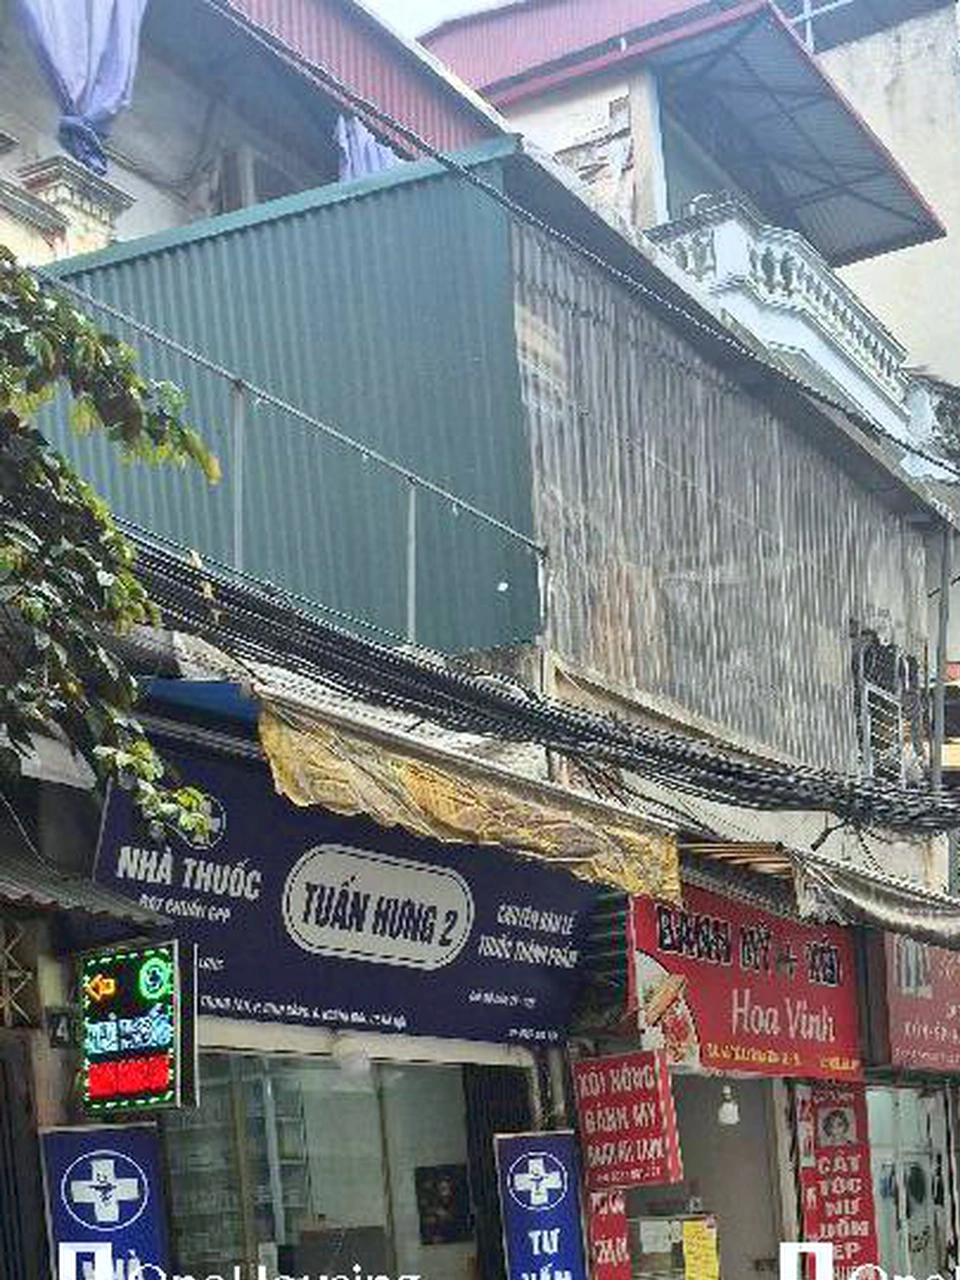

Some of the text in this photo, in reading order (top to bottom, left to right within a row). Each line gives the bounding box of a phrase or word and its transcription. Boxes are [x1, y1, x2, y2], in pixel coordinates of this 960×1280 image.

[116, 845, 262, 900] NHÀ THUỐC
[302, 875, 371, 932] TUẤN
[438, 909, 458, 946] 2
[732, 988, 780, 1036] Hoa
[528, 1227, 561, 1256] TƯ
